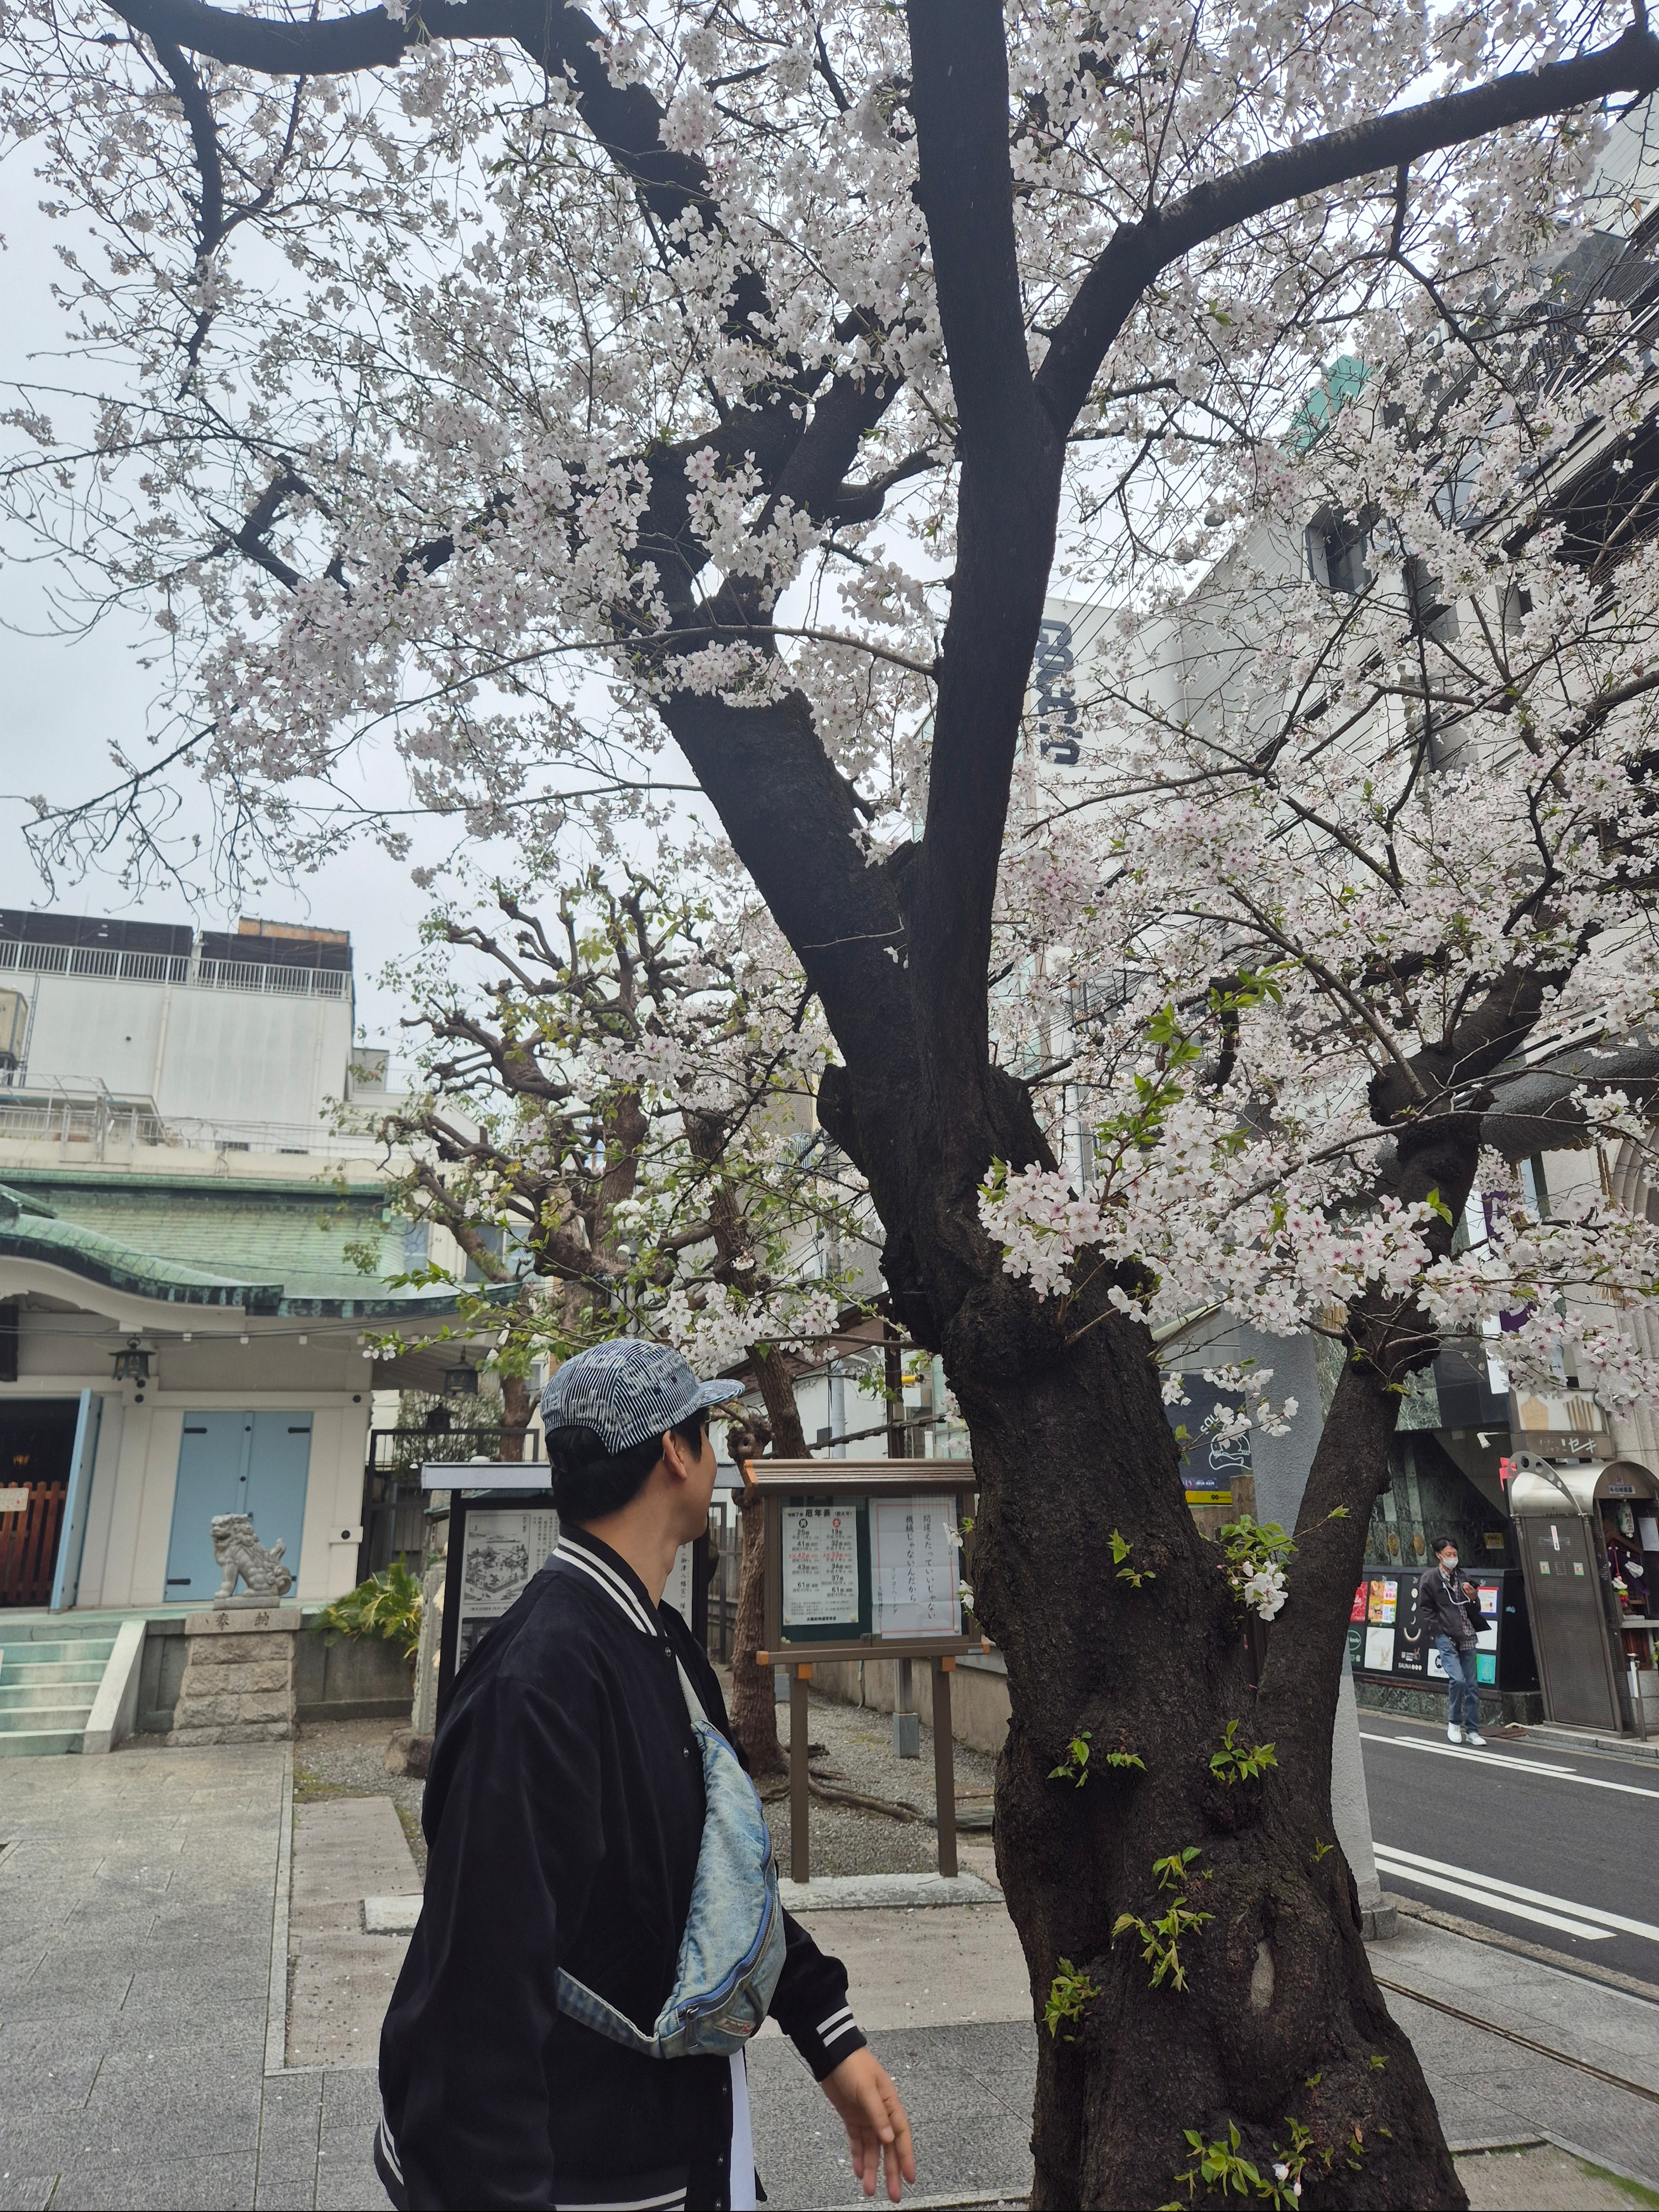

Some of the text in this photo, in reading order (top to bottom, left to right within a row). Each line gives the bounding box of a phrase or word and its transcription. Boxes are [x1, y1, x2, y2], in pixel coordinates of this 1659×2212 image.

[805, 1509, 831, 1517] 厄年表
[906, 1515, 916, 1603] 機械じゃないんだから
